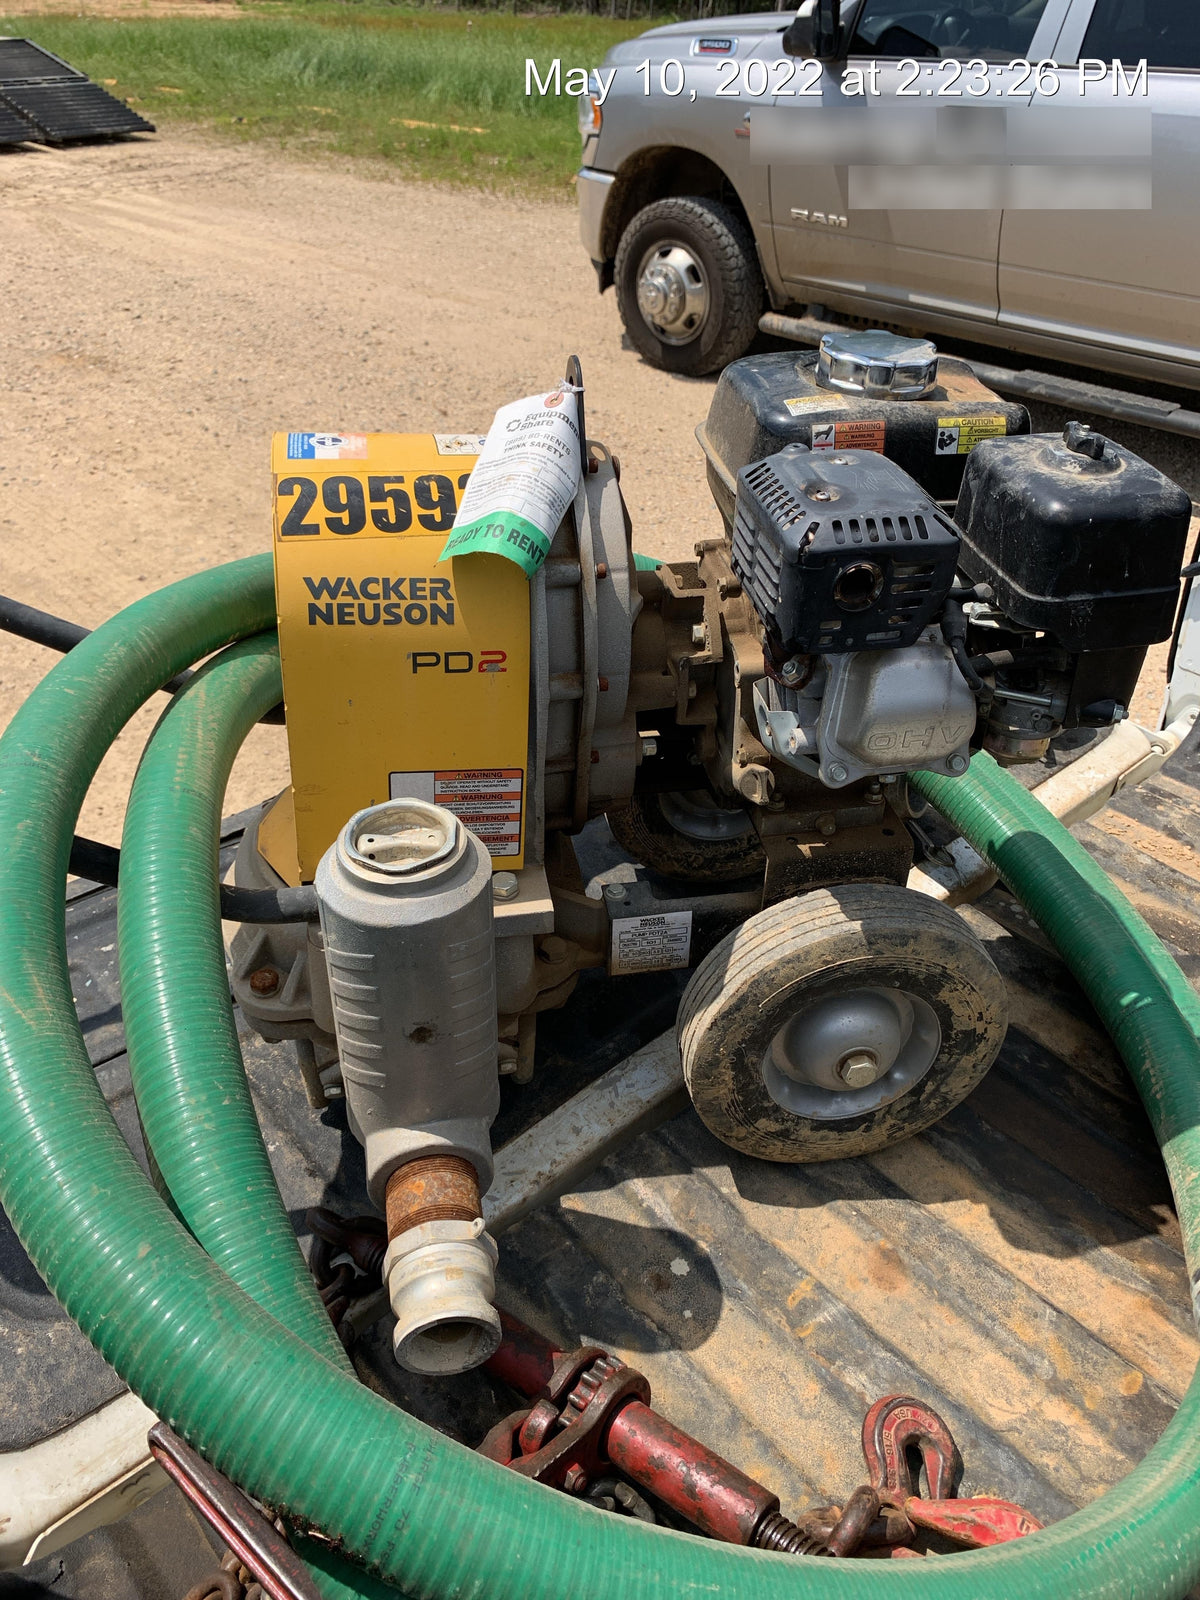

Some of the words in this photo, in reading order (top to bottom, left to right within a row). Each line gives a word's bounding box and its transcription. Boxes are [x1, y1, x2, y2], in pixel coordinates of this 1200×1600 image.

[790, 207, 848, 228] RAM
[847, 422, 881, 431] WARNING
[961, 418, 994, 426] CAUTION
[504, 441, 527, 453] THINK
[529, 441, 564, 459] SAFETY
[278, 473, 471, 536] 2959
[445, 524, 483, 552] READY
[484, 523, 505, 538] TO
[506, 528, 545, 565] RENT
[302, 577, 454, 600] WACKER
[308, 603, 455, 625] NEUSON
[412, 650, 507, 674] PD2
[868, 726, 968, 750] OHV
[893, 1408, 912, 1419] USA
